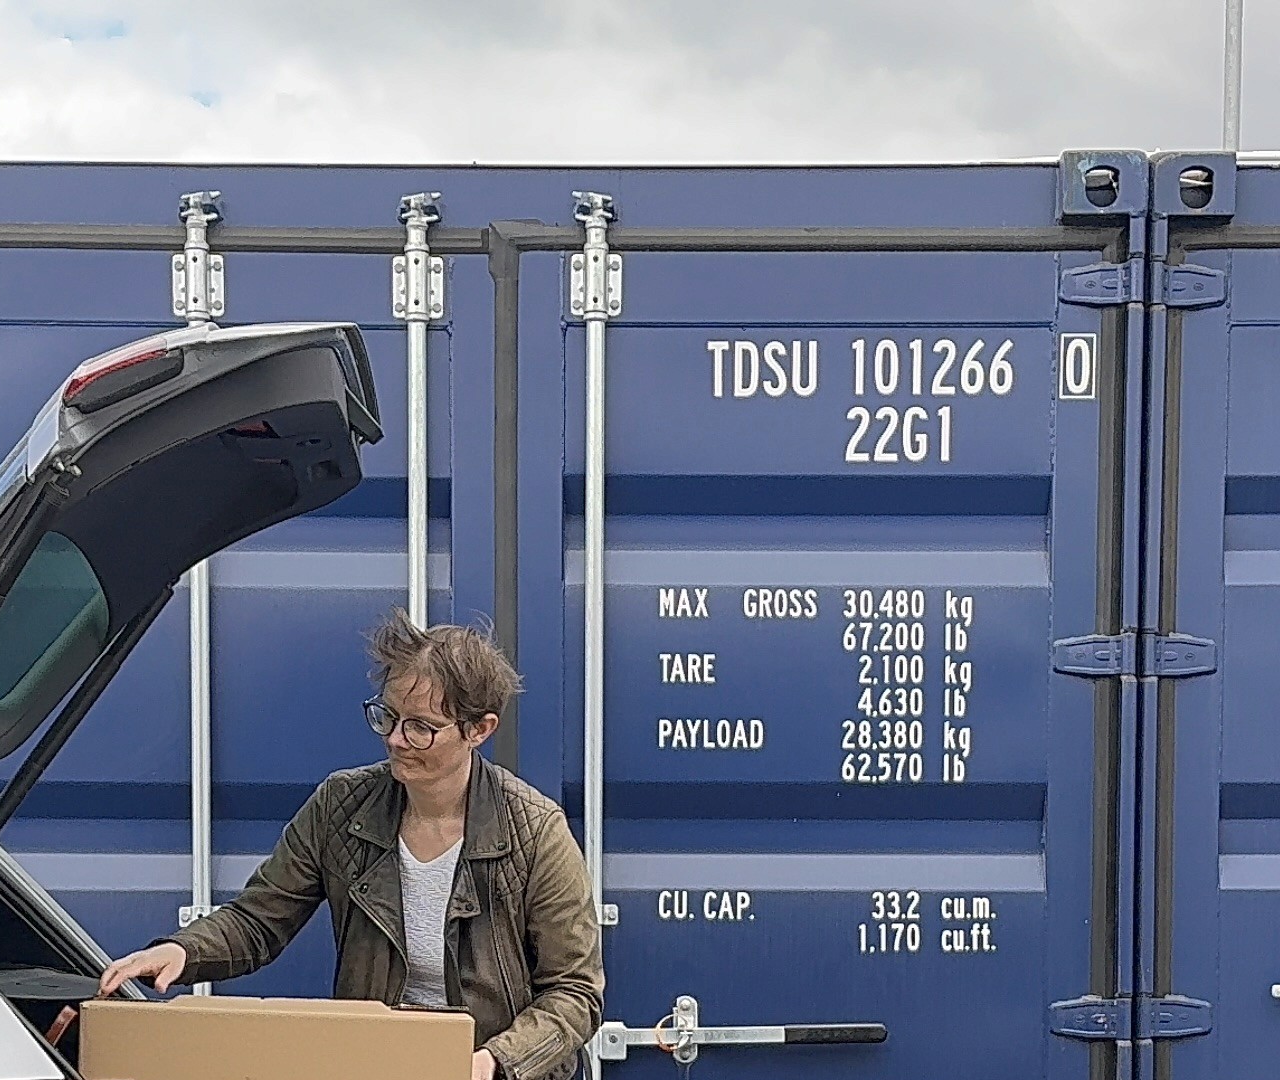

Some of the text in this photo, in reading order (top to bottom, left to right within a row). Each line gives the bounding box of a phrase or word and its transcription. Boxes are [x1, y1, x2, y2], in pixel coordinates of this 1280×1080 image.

[708, 338, 1090, 397] TDSU 101266 0
[846, 407, 951, 462] 22G1
[660, 589, 708, 617] MAX
[744, 589, 818, 618] GROSS
[946, 590, 973, 626] kg
[946, 623, 967, 651] lb
[660, 654, 716, 683] TARE
[945, 656, 972, 692] kg
[945, 688, 966, 717] lb
[659, 720, 764, 749] PAYLOAD
[944, 721, 971, 757] kg
[944, 754, 965, 782] lb
[659, 890, 997, 920] CU. CAP. 33.2 cu.m.
[941, 923, 997, 951] cu.ft.
